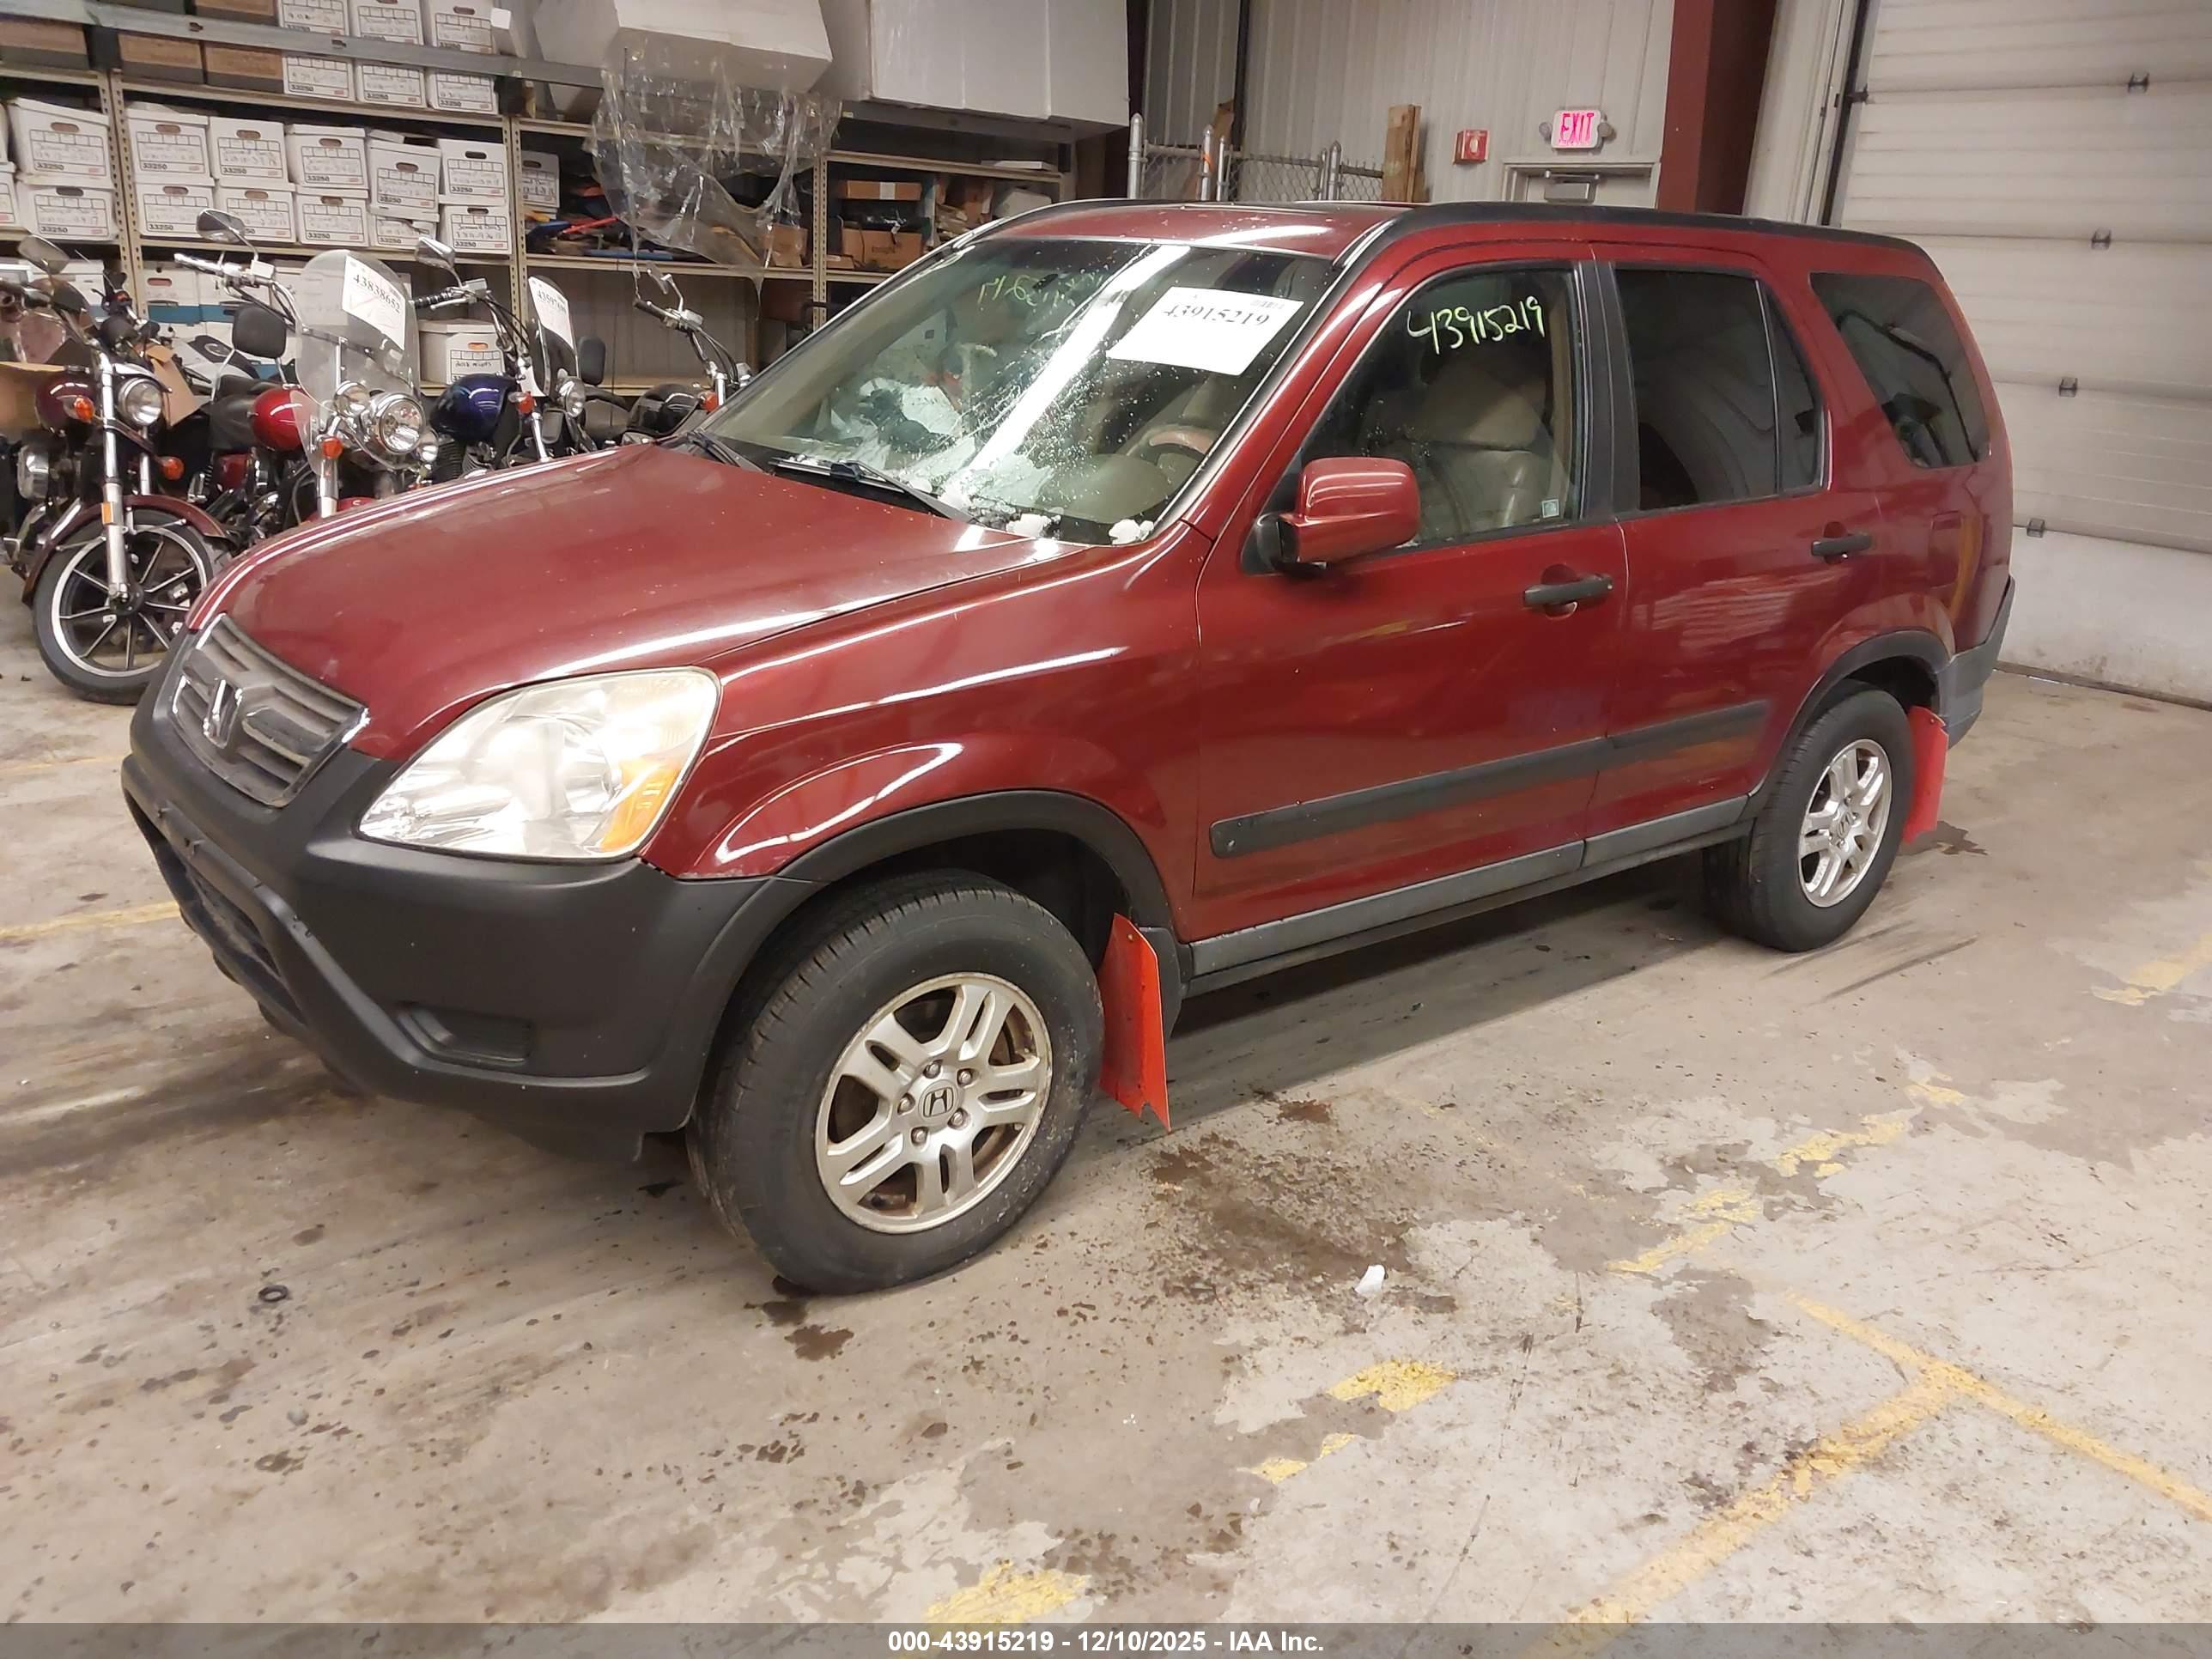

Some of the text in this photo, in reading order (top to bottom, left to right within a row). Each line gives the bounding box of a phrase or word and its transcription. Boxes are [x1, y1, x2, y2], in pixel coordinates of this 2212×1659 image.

[1560, 112, 1595, 144] EXIT
[353, 274, 400, 314] 43838652
[1163, 304, 1271, 326] 43915219
[1407, 295, 1546, 355] 43915219
